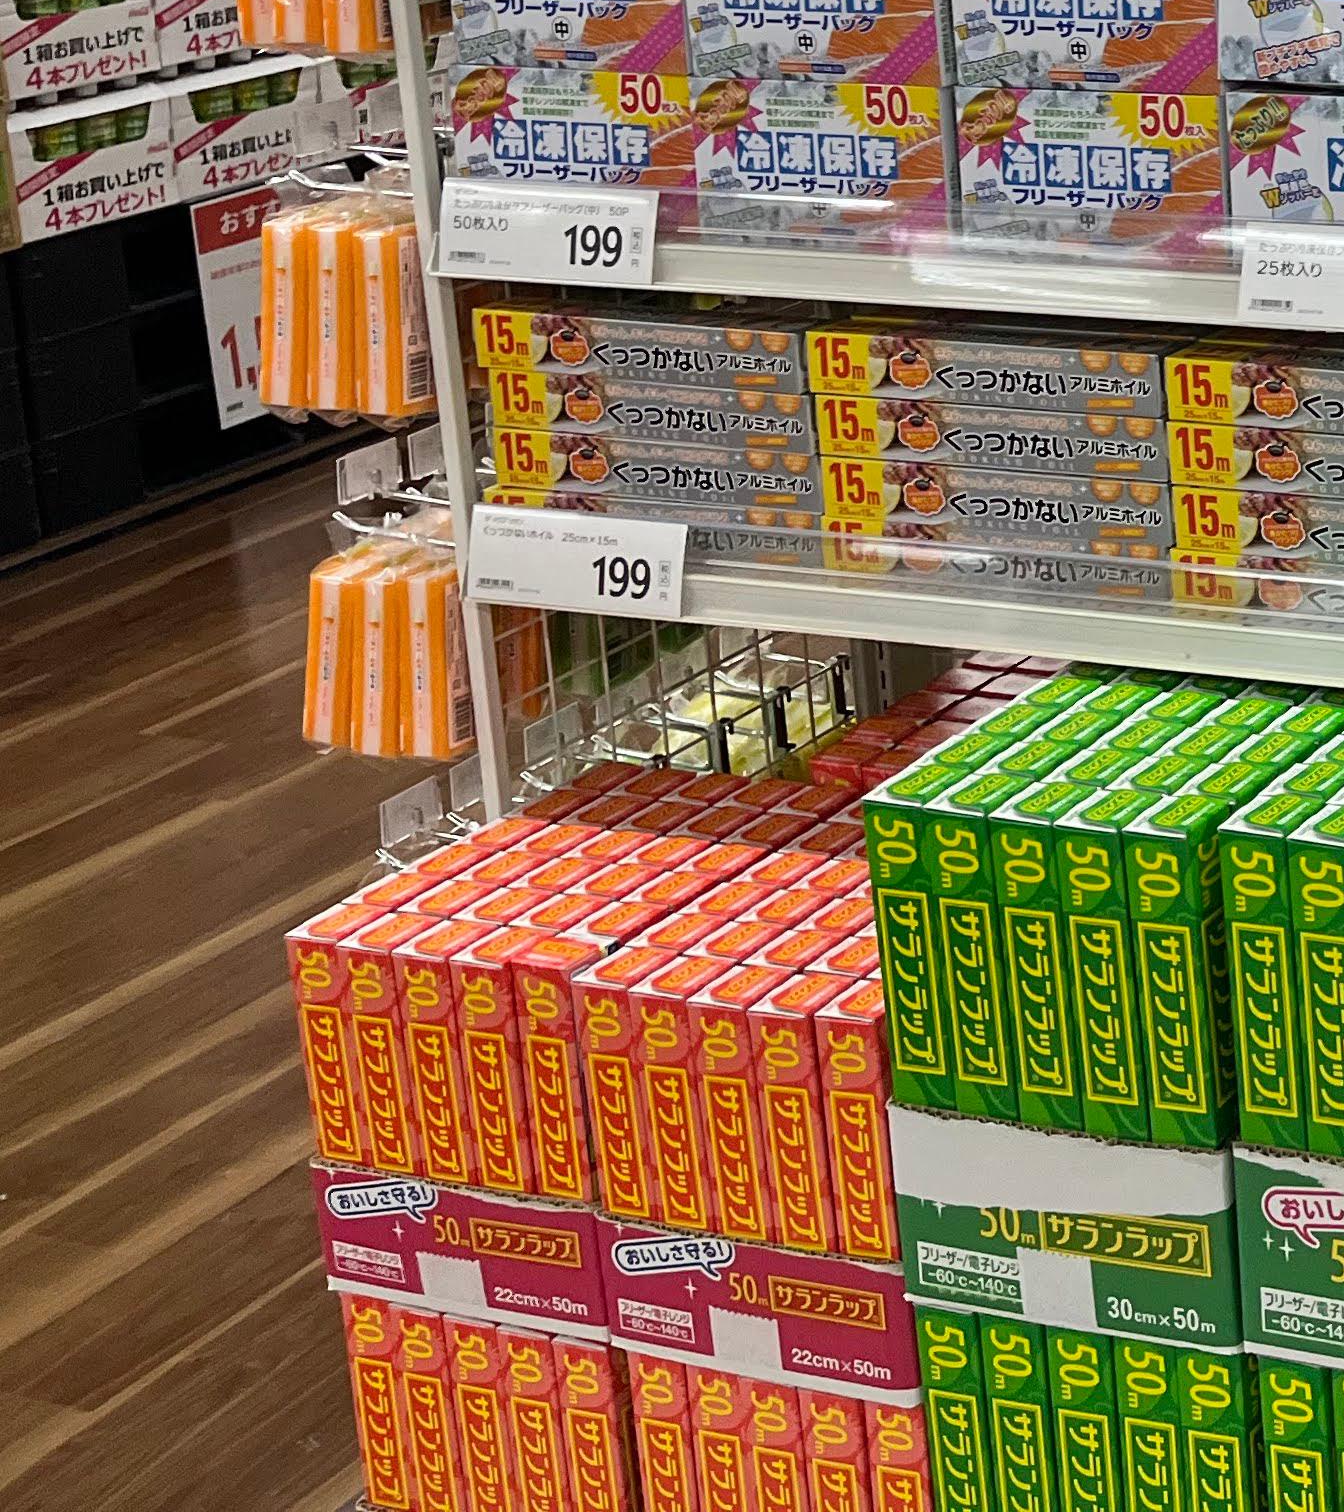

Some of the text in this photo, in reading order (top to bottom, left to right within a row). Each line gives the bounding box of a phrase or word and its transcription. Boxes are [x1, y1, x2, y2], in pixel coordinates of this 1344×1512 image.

[494, 0, 628, 20] フリーザーバッグ
[733, 12, 875, 33] フリーザーバッグ
[1001, 19, 1154, 40] フリーザーバッグ
[23, 26, 145, 65] 1箱お買い上げで
[797, 32, 814, 52] 中
[1070, 41, 1088, 62] 中
[26, 50, 147, 90] 4本プレゼント!
[43, 162, 165, 206] 1箱お買い上げで
[45, 185, 167, 231] 4本プレゼント!
[453, 215, 509, 232] 50枚入り
[564, 224, 623, 268] 199
[1256, 260, 1323, 279] 25枚入り
[481, 313, 529, 357] 15m
[815, 336, 866, 381] 15m
[1174, 363, 1229, 410] 15m
[1181, 492, 1237, 538] 15m
[592, 555, 651, 600] 199
[1301, 856, 1344, 923] 50m
[873, 816, 936, 1065] 50m サランラップ
[297, 948, 355, 1156] 50m サランラップ
[584, 996, 650, 1217] 50m サランラップ
[337, 1186, 429, 1208] おいしさ守る!
[431, 1214, 576, 1260] 50m サランラップ
[624, 1239, 724, 1266] おいしさ守る!
[979, 1207, 1200, 1265] 50m サランラップ
[919, 1246, 1021, 1277] フリーザー/電子レンジ
[493, 1285, 589, 1318] 22cm×50m
[729, 1271, 879, 1321] 50m サランラップ
[1105, 1295, 1217, 1334] 30cm×50m
[790, 1347, 893, 1381] 22cm×50m
